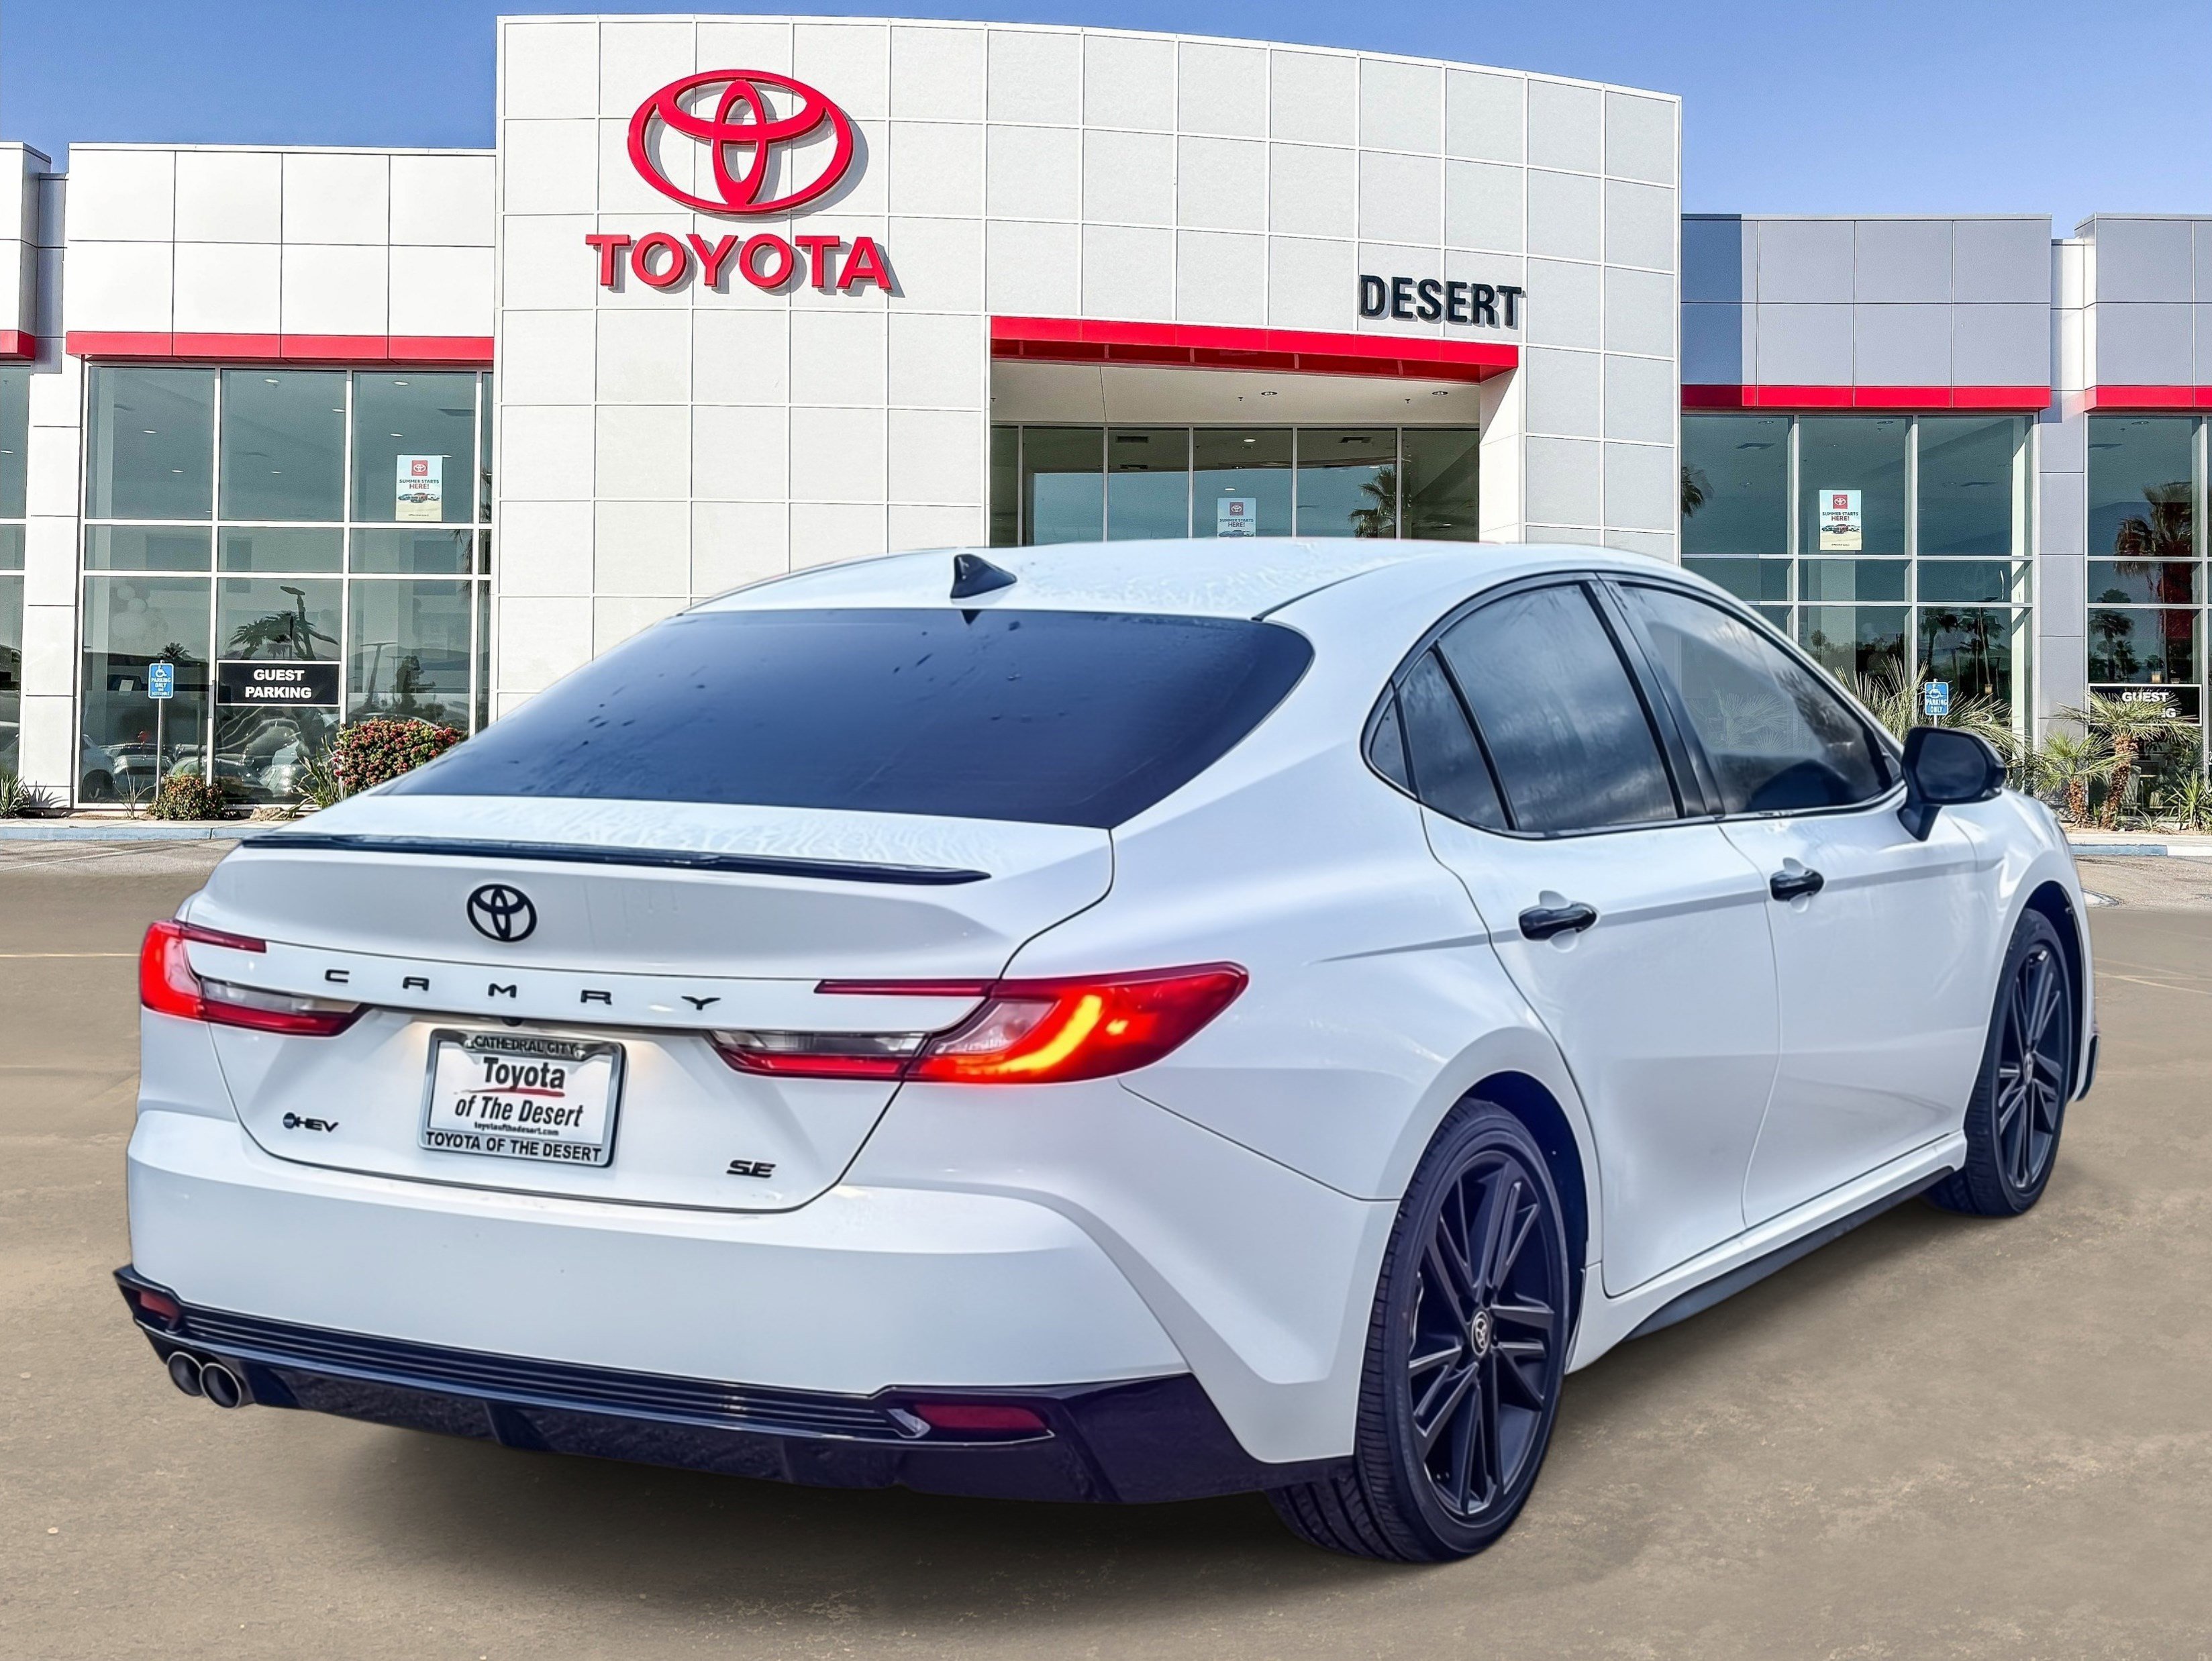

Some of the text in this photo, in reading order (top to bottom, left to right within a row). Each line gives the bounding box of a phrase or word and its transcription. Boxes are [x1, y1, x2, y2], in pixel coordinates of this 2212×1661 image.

[585, 232, 893, 289] TOYOTA
[1359, 274, 1522, 327] DESERT
[254, 669, 305, 681] GUEST
[245, 687, 311, 699] PARKING
[2122, 692, 2169, 703] GUEST
[325, 969, 721, 1010] CAMRY
[474, 1035, 578, 1054] CATHEDRAL CITY
[483, 1057, 565, 1090] Toyota
[454, 1095, 583, 1127] of The Desert
[426, 1131, 601, 1162] TOYOTA OF THE DESERT
[726, 1160, 776, 1178] SE
